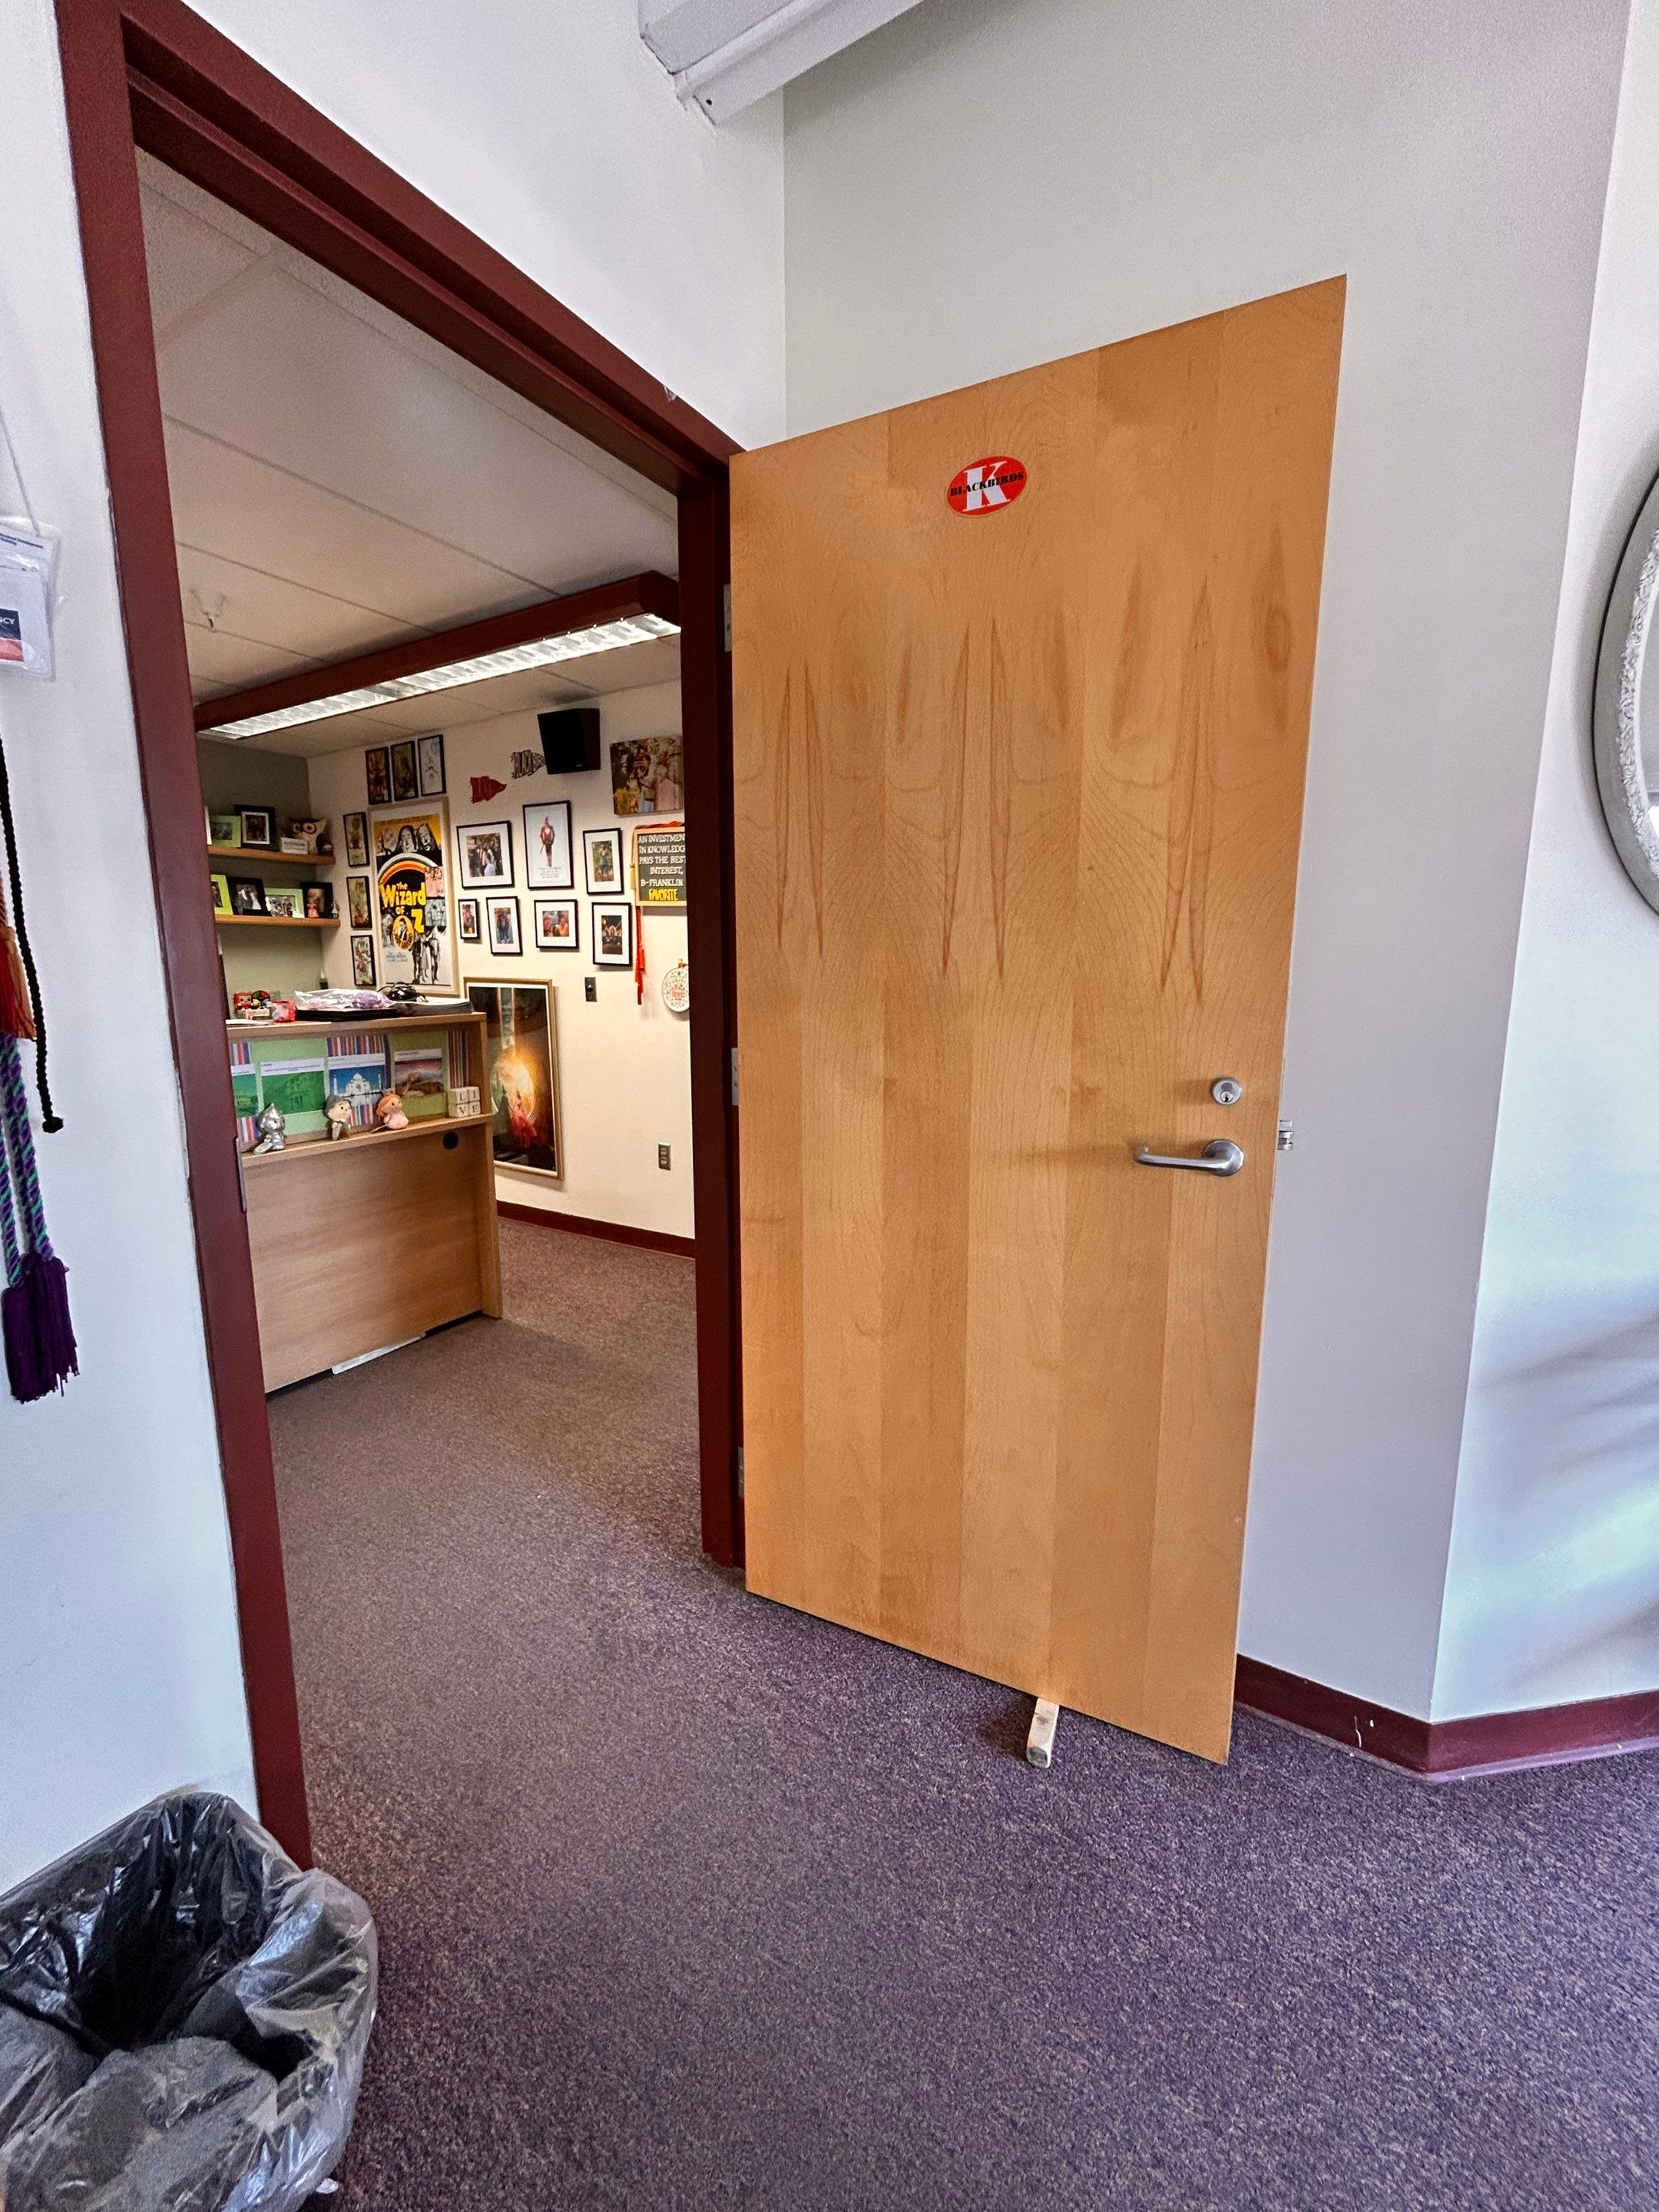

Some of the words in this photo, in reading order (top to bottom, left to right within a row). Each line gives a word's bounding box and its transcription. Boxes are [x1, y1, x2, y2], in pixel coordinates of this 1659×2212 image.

[949, 472, 1024, 496] BLACKBIRDS
[962, 461, 1011, 512] K
[649, 833, 685, 843] INVESTMEN
[654, 856, 669, 864] THE
[379, 882, 426, 908] Wizard
[648, 889, 679, 901] FAVORITE
